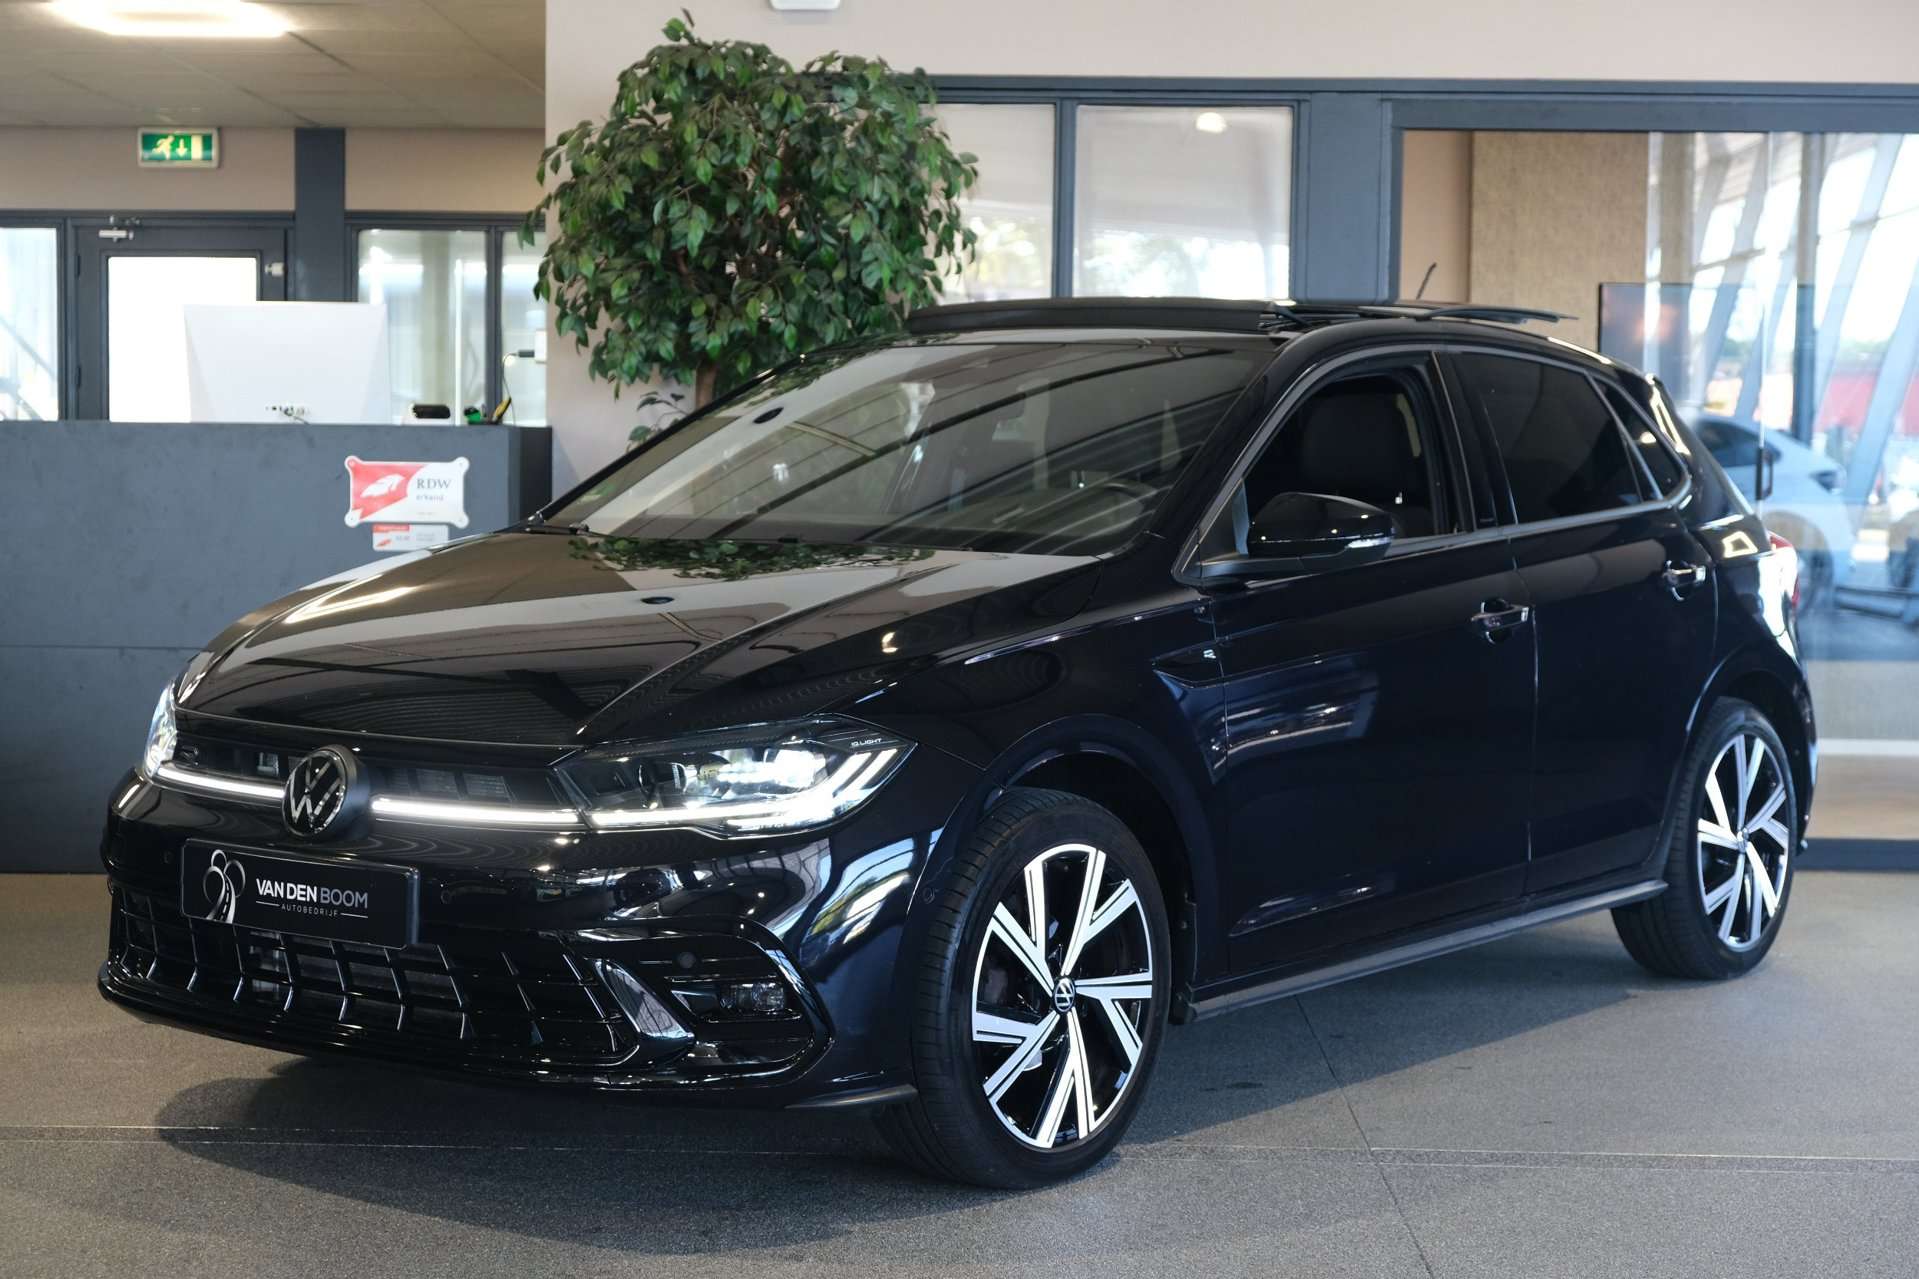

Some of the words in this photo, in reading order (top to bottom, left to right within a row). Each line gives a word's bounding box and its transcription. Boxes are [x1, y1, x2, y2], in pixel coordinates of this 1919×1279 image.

[416, 478, 452, 489] RDW
[256, 878, 284, 899] VAN
[286, 882, 318, 903] DEN
[320, 887, 369, 909] BOOM
[281, 903, 339, 917] AUTOBEDRIJF
